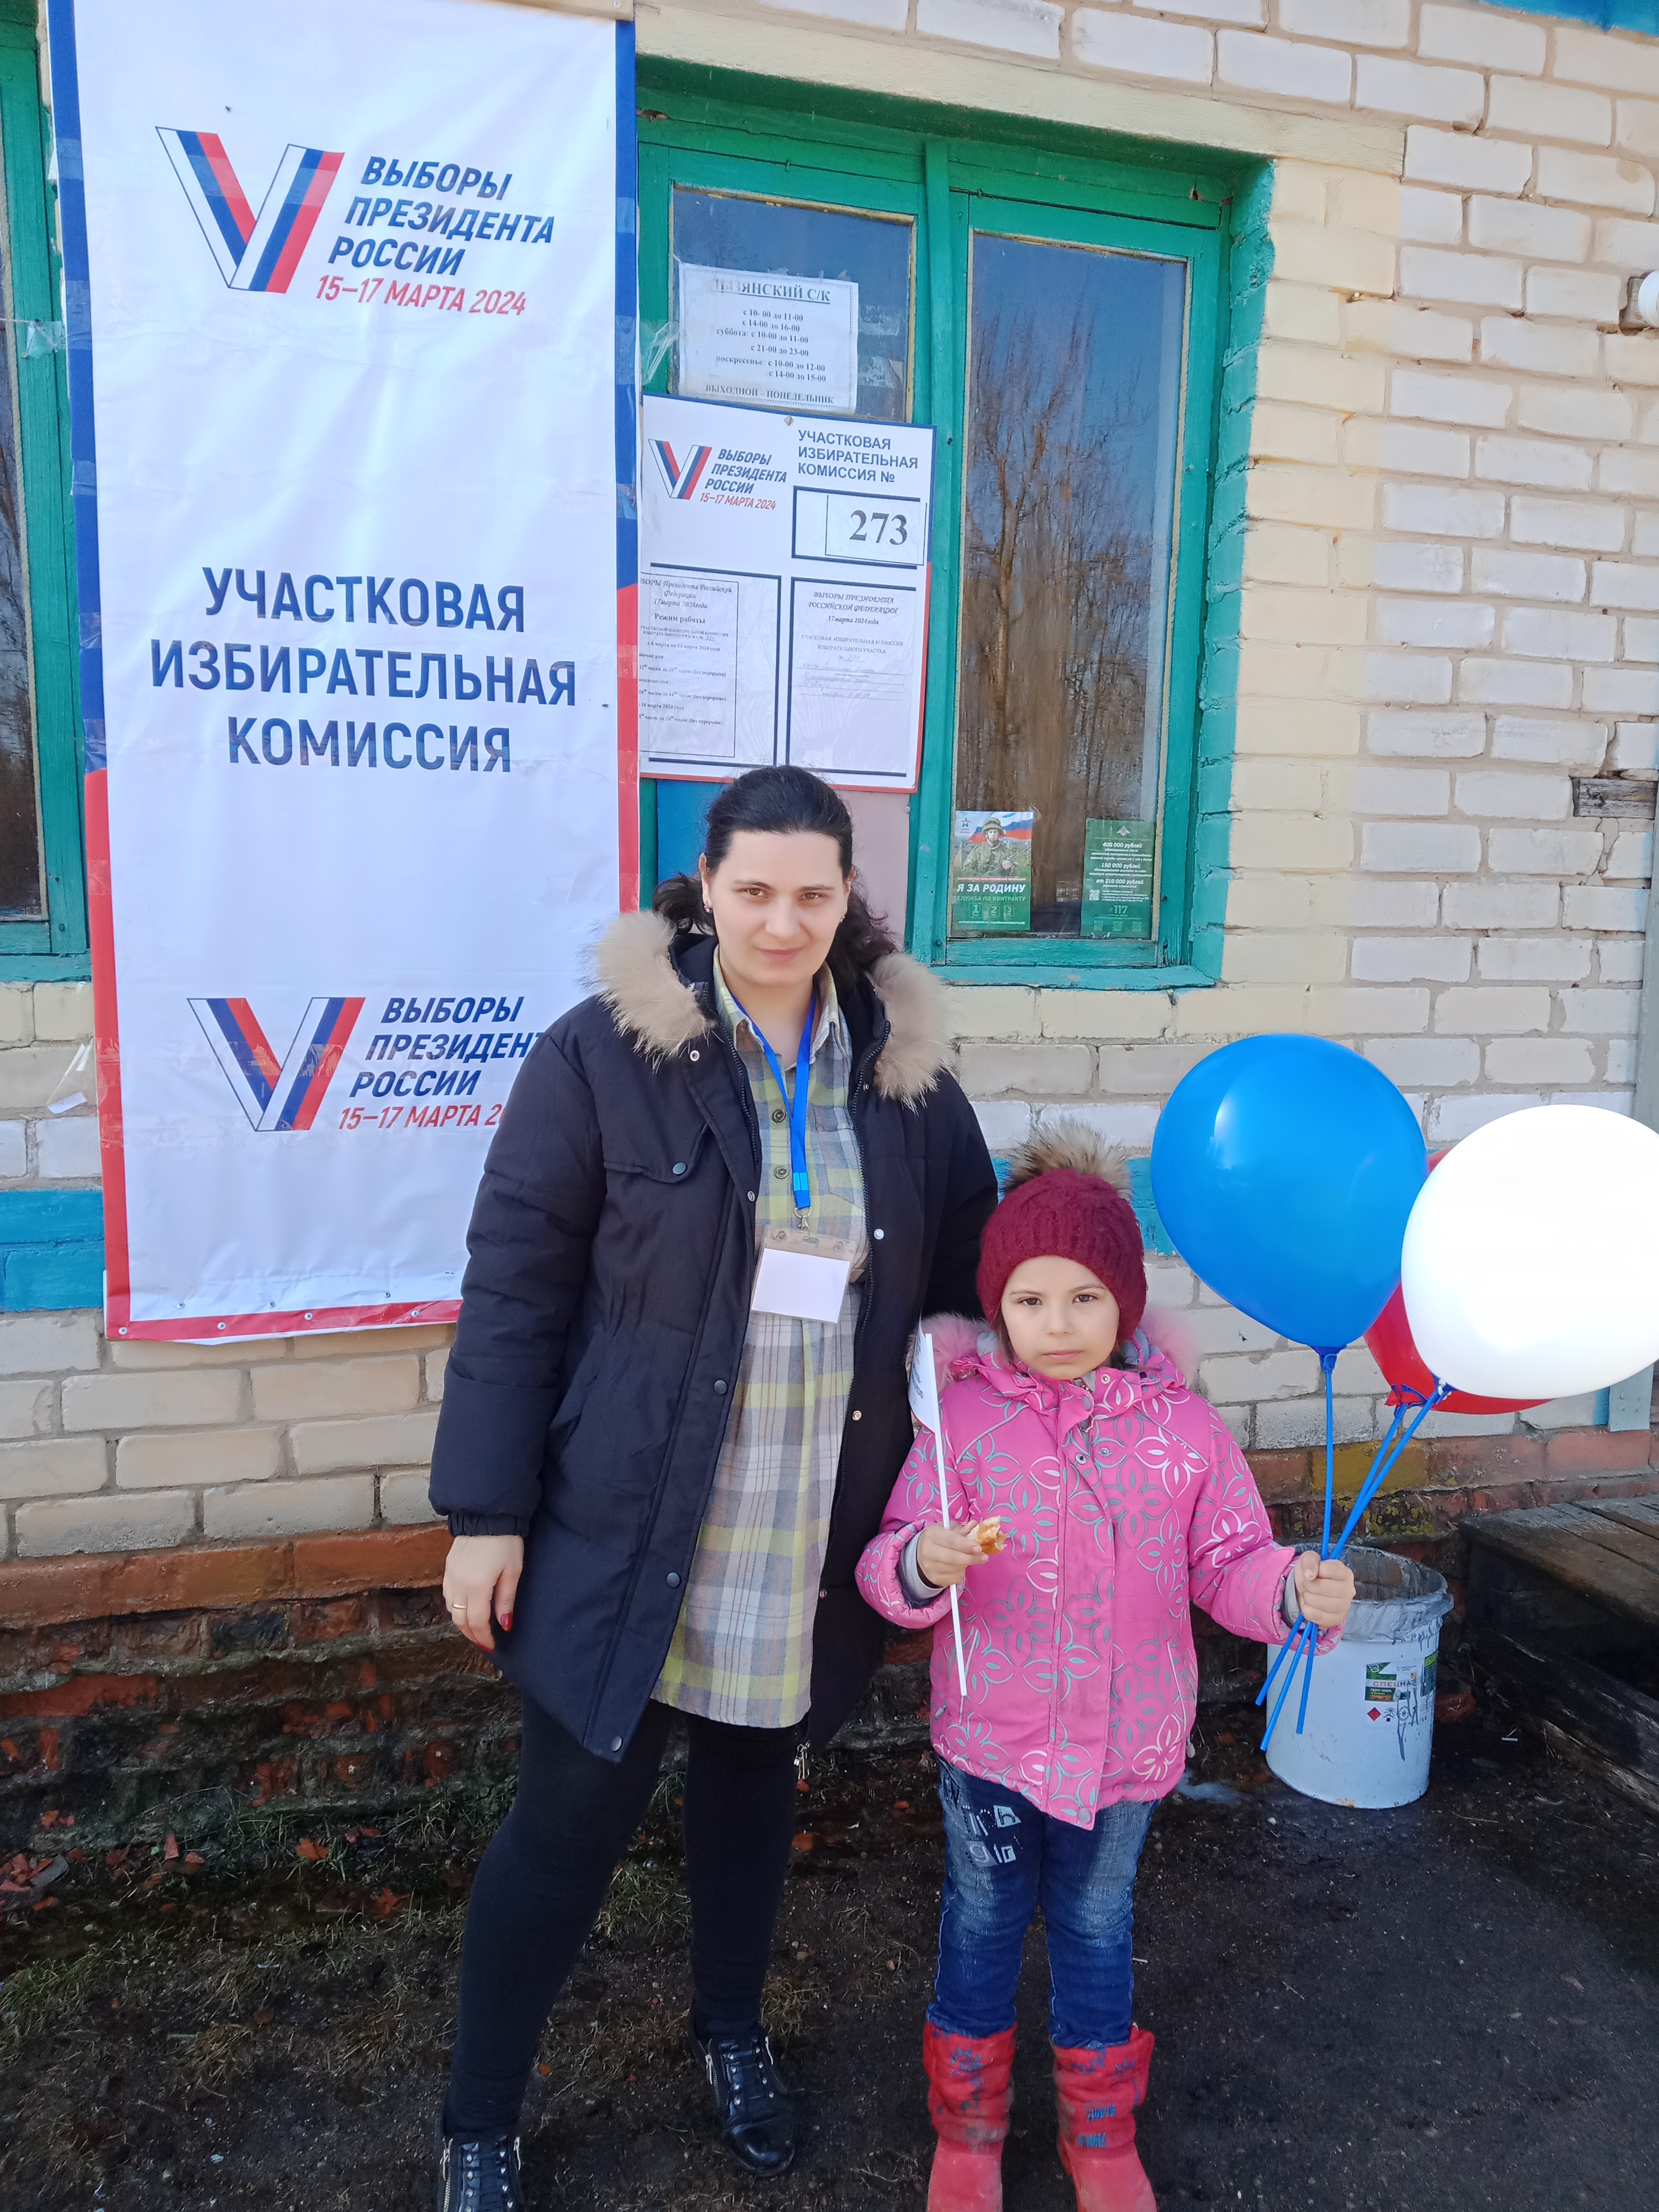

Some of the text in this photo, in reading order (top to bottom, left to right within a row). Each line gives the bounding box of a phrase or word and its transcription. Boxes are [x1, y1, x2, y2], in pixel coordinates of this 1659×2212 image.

[361, 156, 513, 200] ВЫБОРЫ
[345, 196, 555, 244] ПРЕЗИДЕНТА
[328, 237, 466, 275] РОССИИ
[384, 280, 464, 313] МАРТА
[468, 289, 527, 315] 2024
[807, 289, 830, 301] С/К
[758, 331, 776, 339] 10-00
[781, 323, 800, 332] 16-00
[706, 385, 758, 396] ВЫХОДНОЙ
[767, 390, 833, 404] ПОНЕДЕЛЬНИК
[798, 430, 891, 450] УЧАСТКОВАЯ
[718, 449, 772, 465] ВЫБОРЫ
[799, 446, 918, 468] ИЗБИРАТЕЛЬНАЯ
[711, 464, 787, 482] ПРЕЗИДЕНТА
[798, 463, 895, 482] КОМИССИЯ №
[705, 478, 755, 494] РОССИИ
[725, 496, 754, 508] МАРТА
[755, 499, 776, 510] 2024
[849, 510, 908, 545] 273
[663, 581, 698, 589] Президента
[699, 584, 732, 593] Российской
[664, 590, 696, 599] Федерации
[202, 567, 525, 633] УЧАСТКОВАЯ
[845, 594, 893, 604] ПРЕЗИДЕНТА
[854, 605, 898, 614] ФЕДЕРАЦИИ
[150, 639, 576, 707] ИЗБИРАТЕЛЬНАЯ
[228, 716, 511, 773] КОМИССИЯ
[983, 884, 1026, 894] РОДИНУ
[1113, 905, 1128, 914] 117
[381, 996, 524, 1024] ВЫБОРЫ
[349, 1070, 482, 1097] РОССИИ
[408, 1104, 481, 1128] МАРТА
